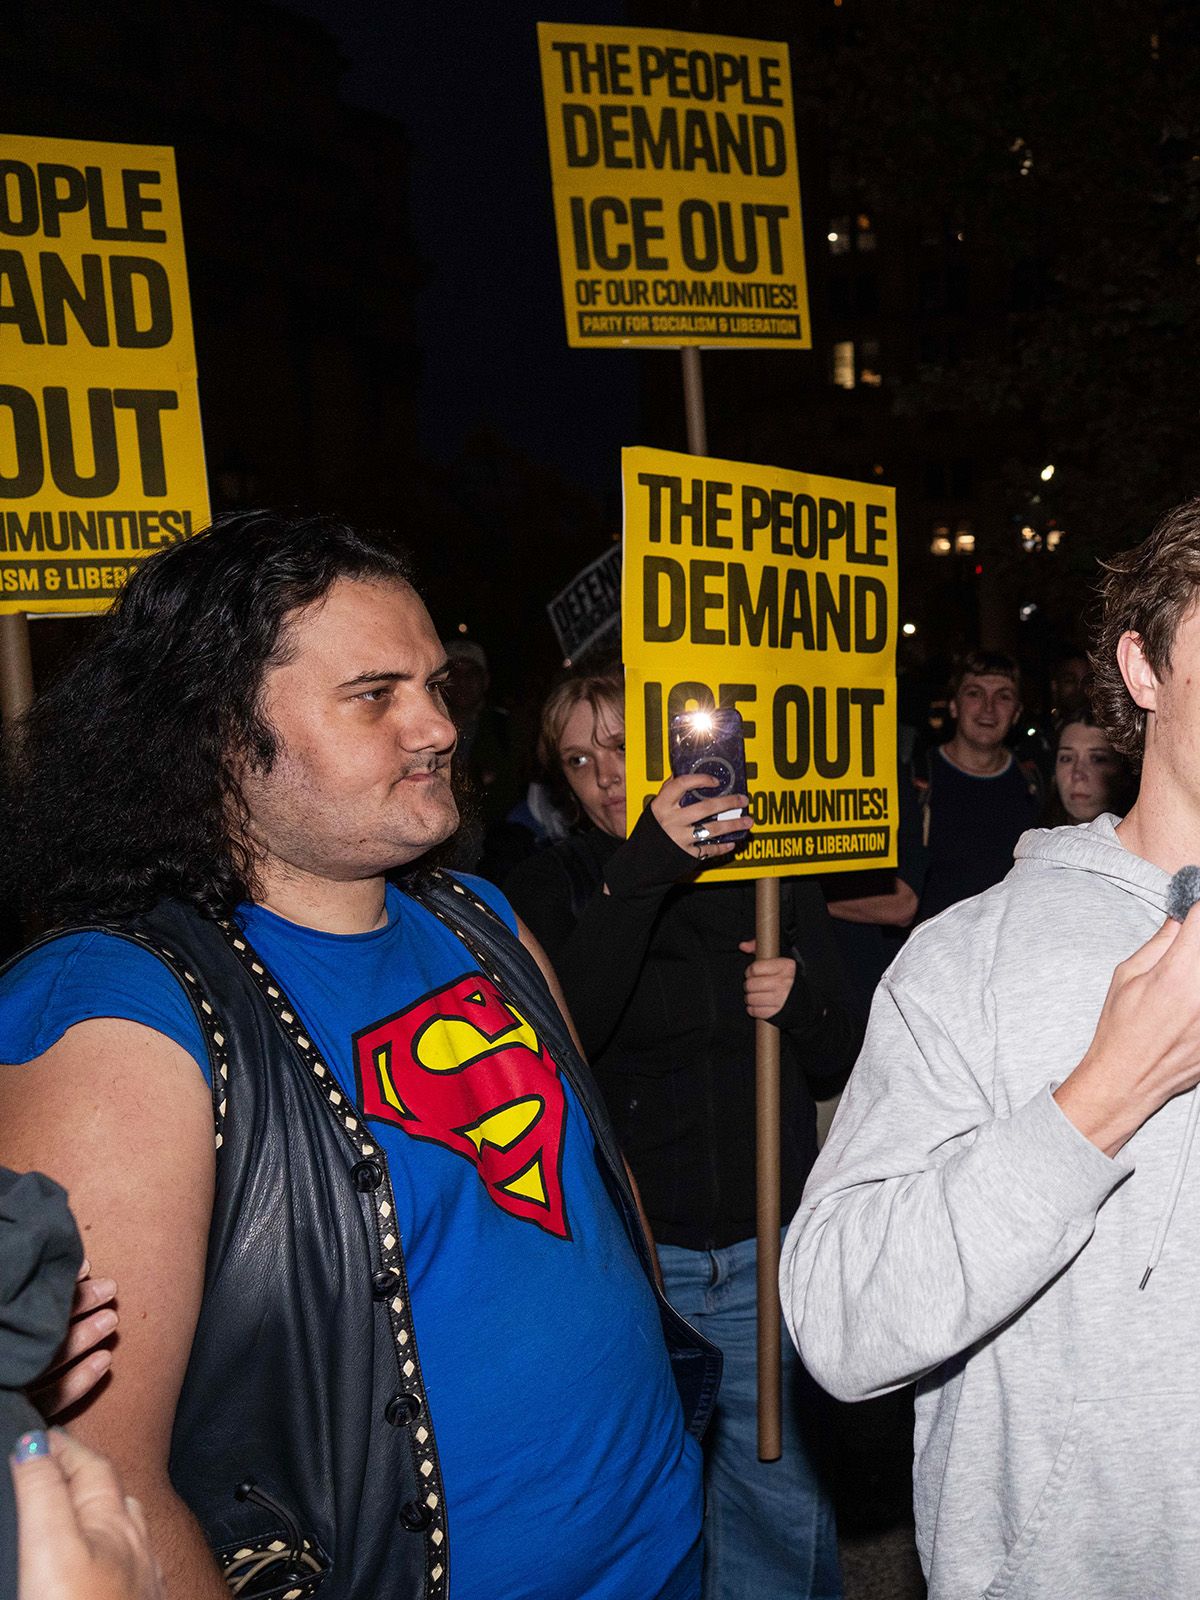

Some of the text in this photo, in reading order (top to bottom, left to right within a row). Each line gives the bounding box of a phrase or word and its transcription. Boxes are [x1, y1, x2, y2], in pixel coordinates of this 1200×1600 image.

[552, 41, 784, 107] THE PEOPLE
[561, 102, 787, 178] DEMAND
[0, 159, 167, 243] OPLE
[569, 195, 789, 276] ICE OUT
[575, 279, 799, 310] OF OUR COMMUNITIES!
[583, 315, 797, 335] PARTY FOR SOCIALISM & LIBERATION
[0, 383, 178, 499] OUT
[0, 510, 192, 551] MUNITIES!
[638, 472, 889, 567] THE PEOPLE
[44, 568, 61, 591] &
[642, 555, 888, 654] DEMAND
[772, 684, 885, 780] OUT
[805, 838, 815, 855] &
[817, 832, 886, 855] LIBERATION
